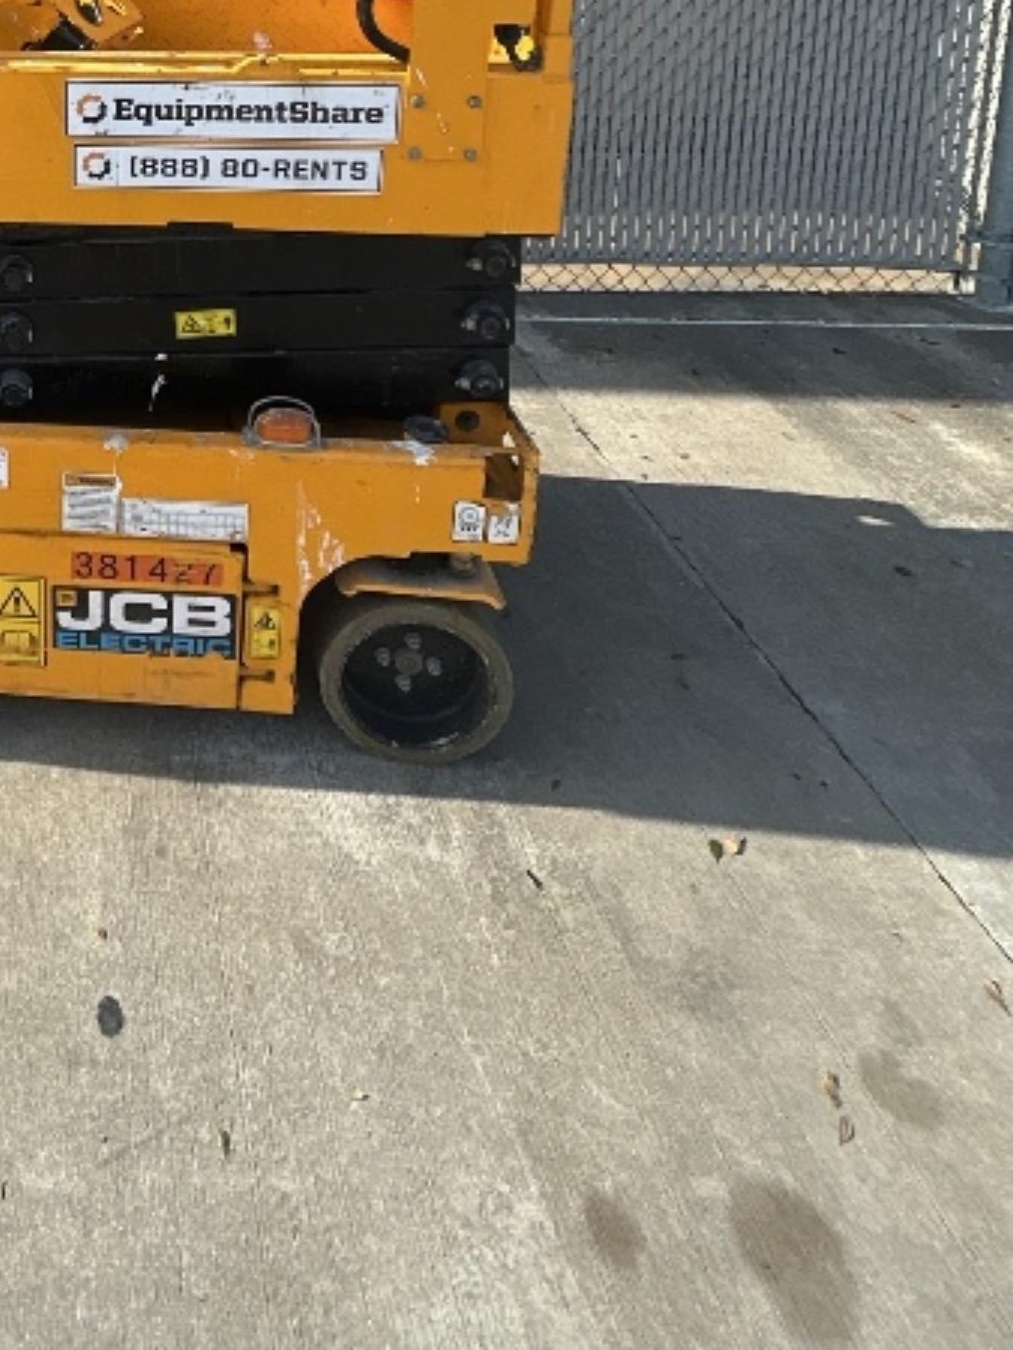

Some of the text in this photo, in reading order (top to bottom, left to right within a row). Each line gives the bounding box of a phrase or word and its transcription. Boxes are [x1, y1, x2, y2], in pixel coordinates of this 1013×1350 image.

[113, 99, 385, 125] EquipmentShare
[130, 156, 368, 181] (888) 80-RENTS
[57, 590, 232, 636] JCB
